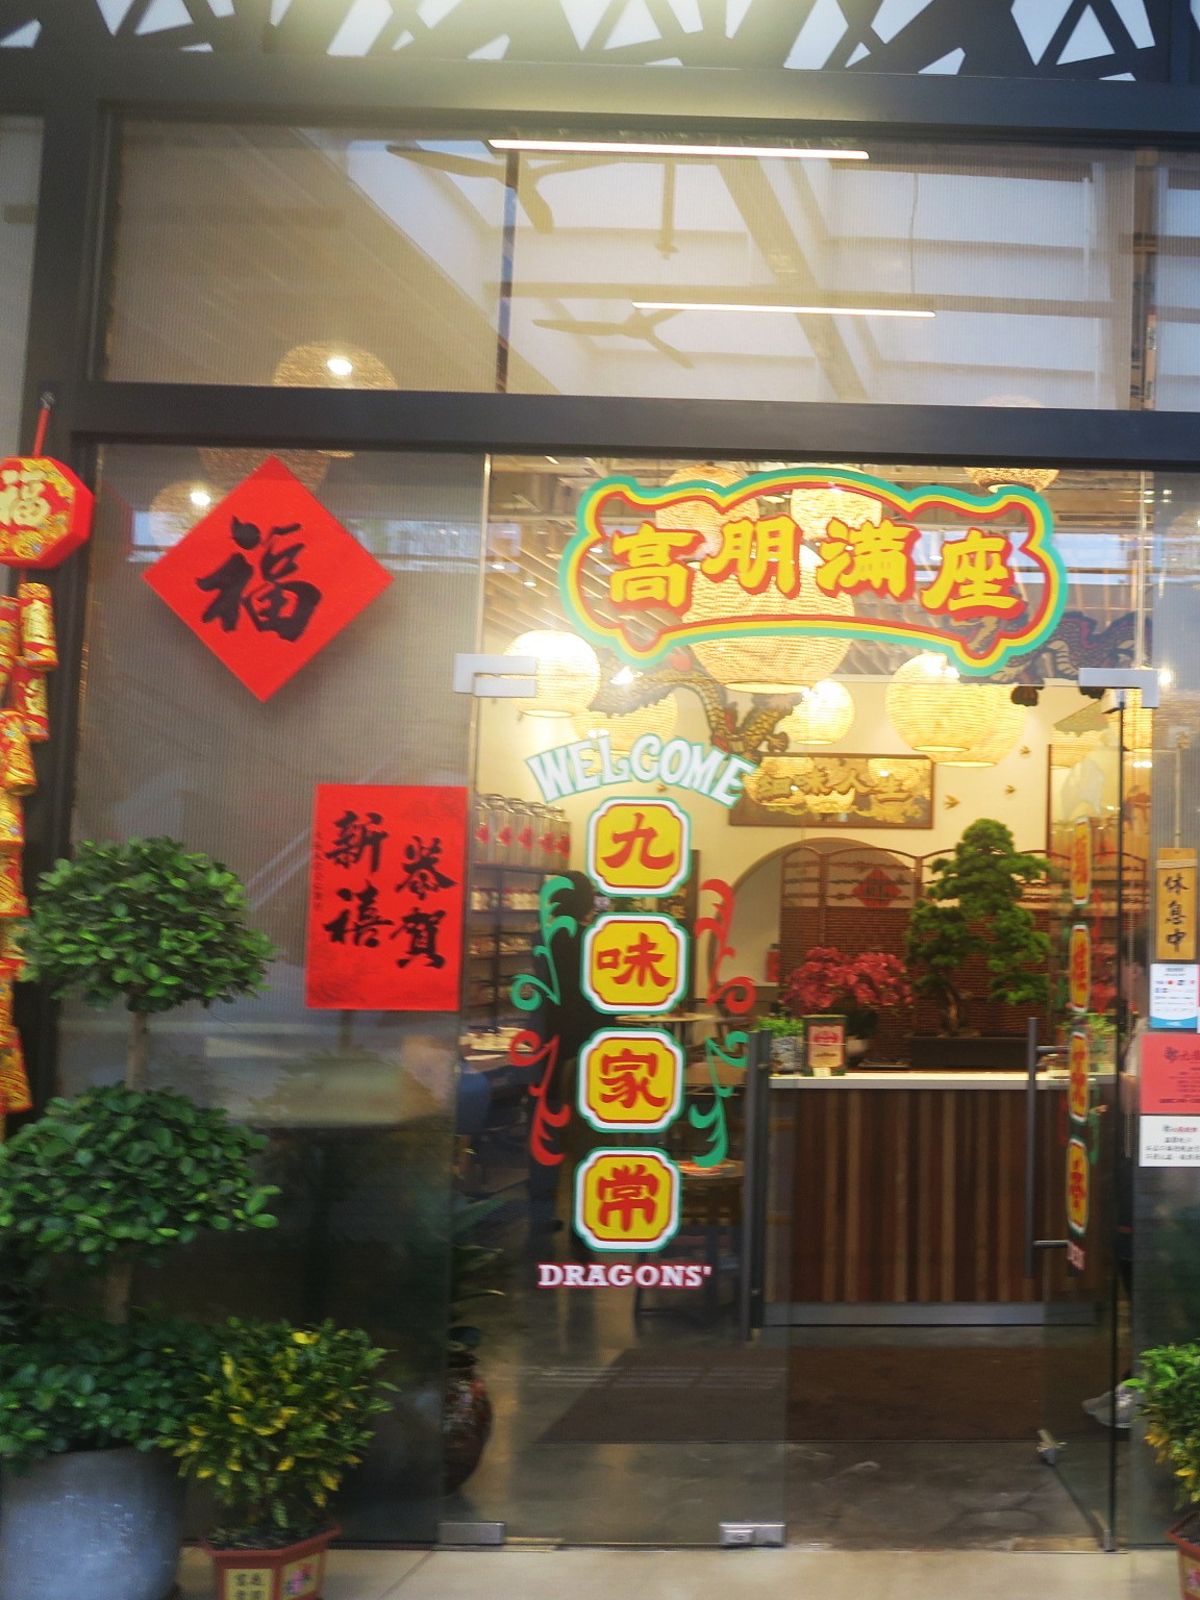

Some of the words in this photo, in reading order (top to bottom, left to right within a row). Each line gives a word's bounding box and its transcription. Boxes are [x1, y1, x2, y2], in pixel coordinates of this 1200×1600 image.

[197, 516, 321, 642] 福
[526, 732, 758, 810] WELCOME
[1164, 872, 1189, 953] 休息中
[537, 1262, 713, 1289] DRAGONS'
